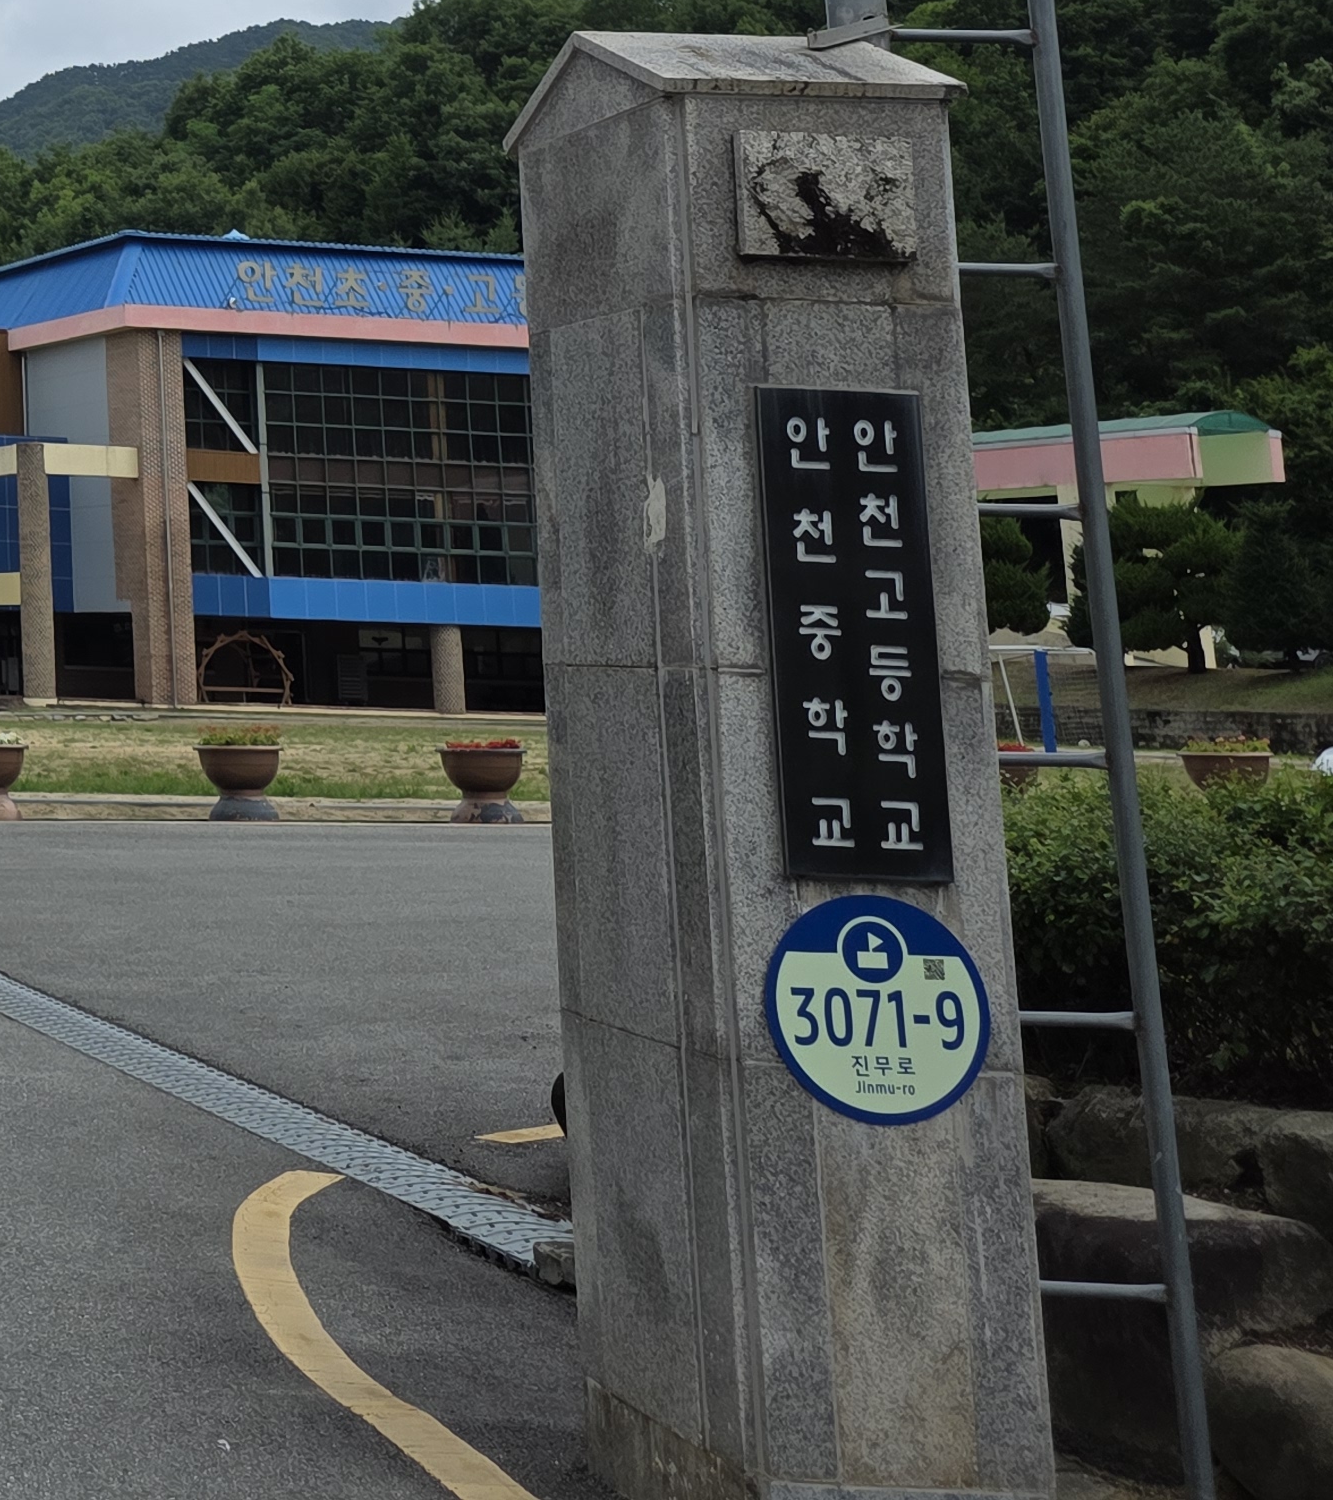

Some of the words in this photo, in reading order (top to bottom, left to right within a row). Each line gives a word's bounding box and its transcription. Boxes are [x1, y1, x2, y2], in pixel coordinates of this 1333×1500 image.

[786, 416, 856, 848] 안천중학교
[853, 419, 924, 851] 안천고등학교
[789, 985, 966, 1052] 3071-9
[851, 1055, 916, 1078] 진무로
[855, 1080, 916, 1096] Jinmu-ro
